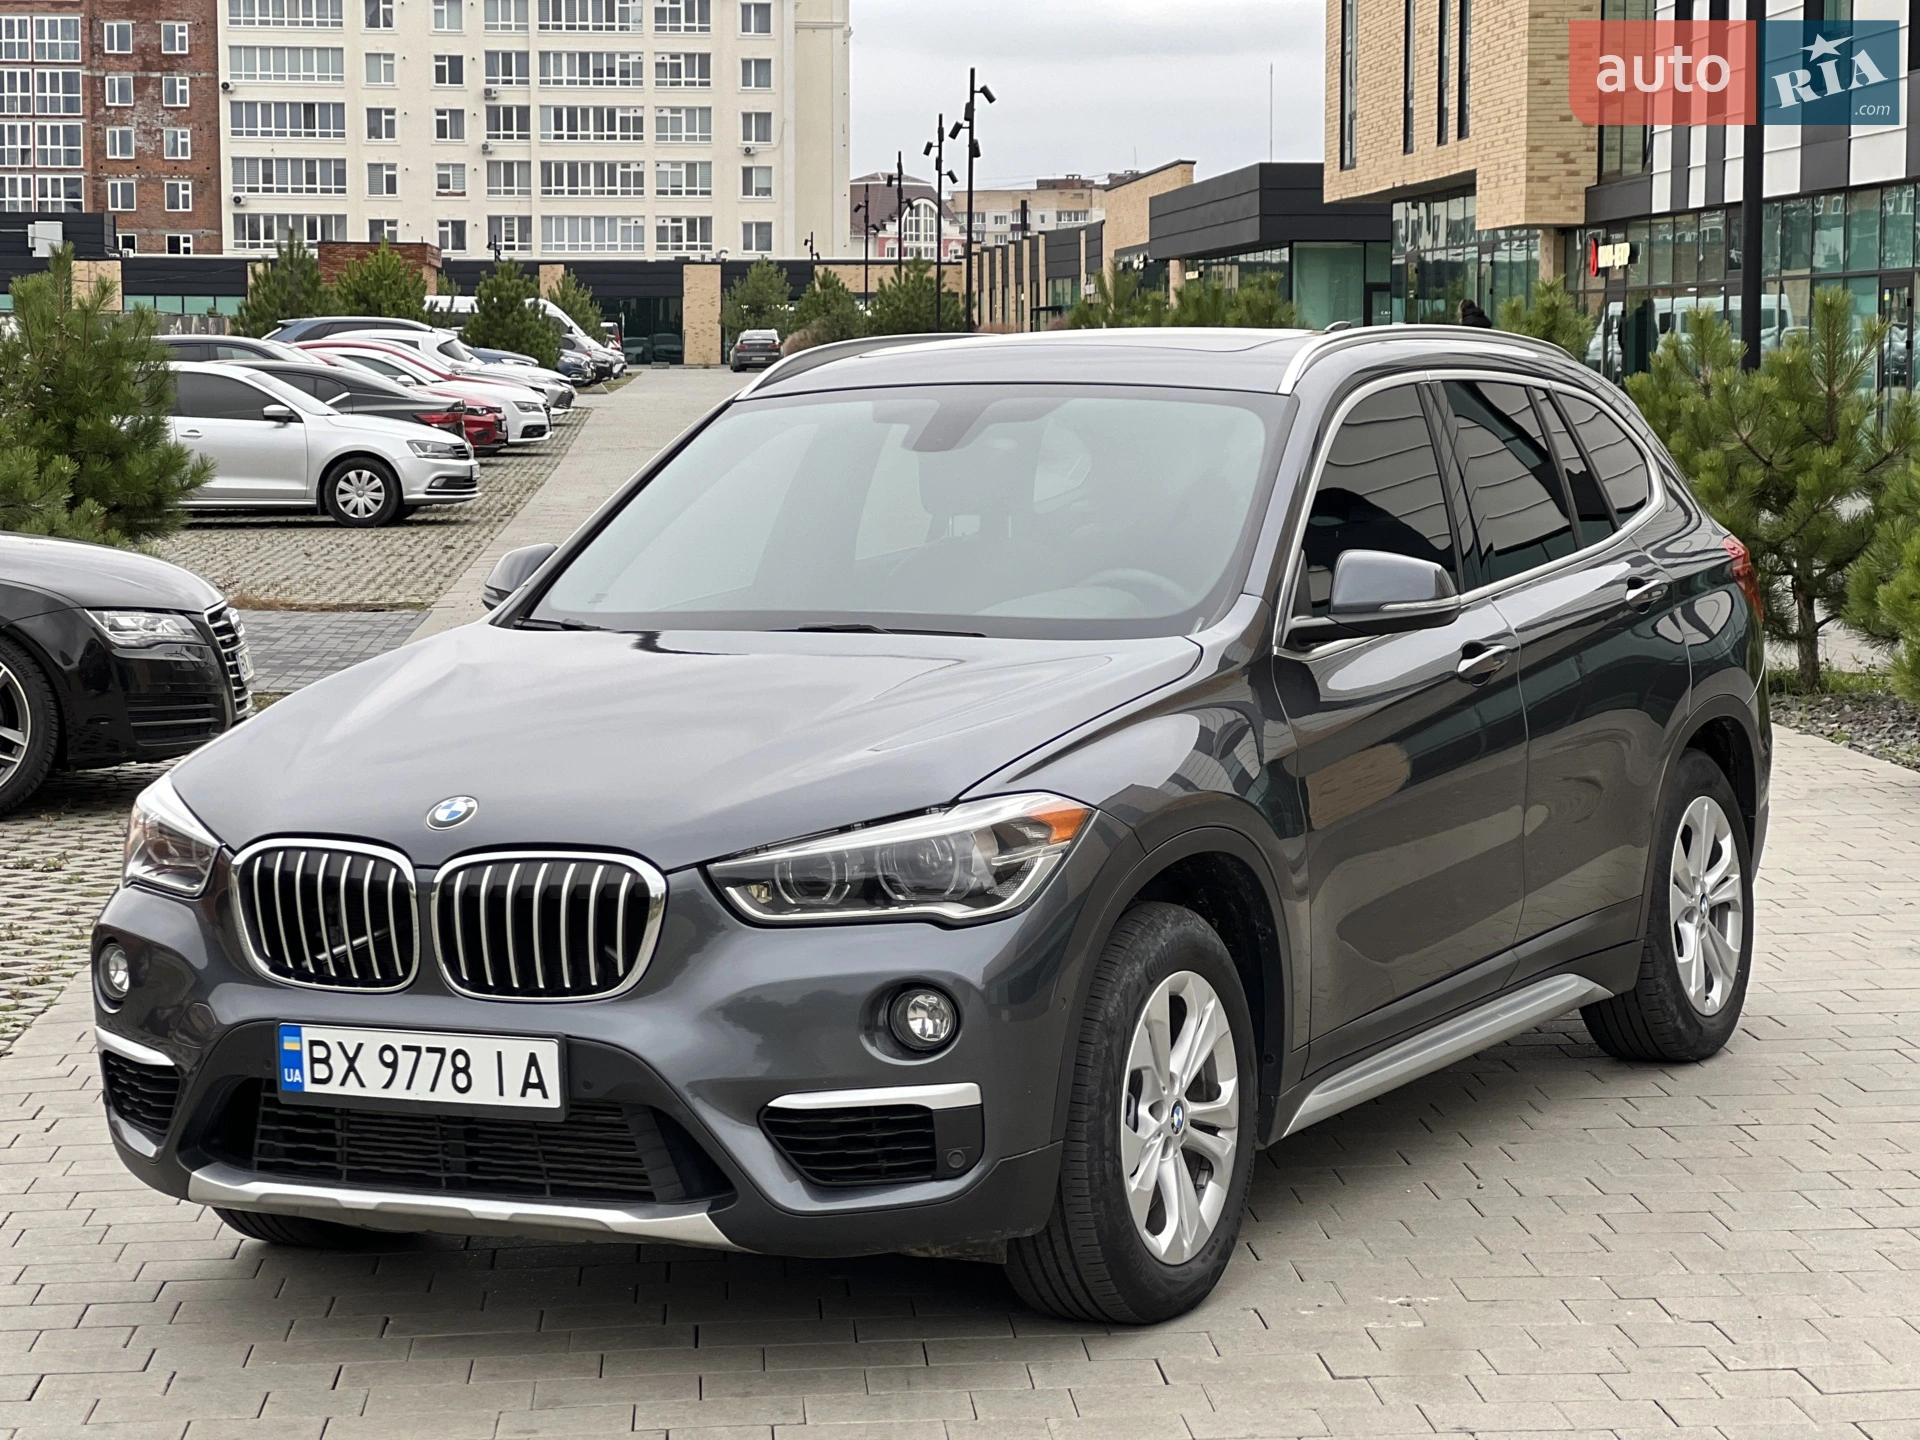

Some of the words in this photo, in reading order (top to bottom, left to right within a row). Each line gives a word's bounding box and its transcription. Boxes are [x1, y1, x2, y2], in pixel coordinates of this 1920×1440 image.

[284, 1068, 303, 1084] UA
[308, 1039, 367, 1089] BX
[378, 1044, 473, 1094] 9778
